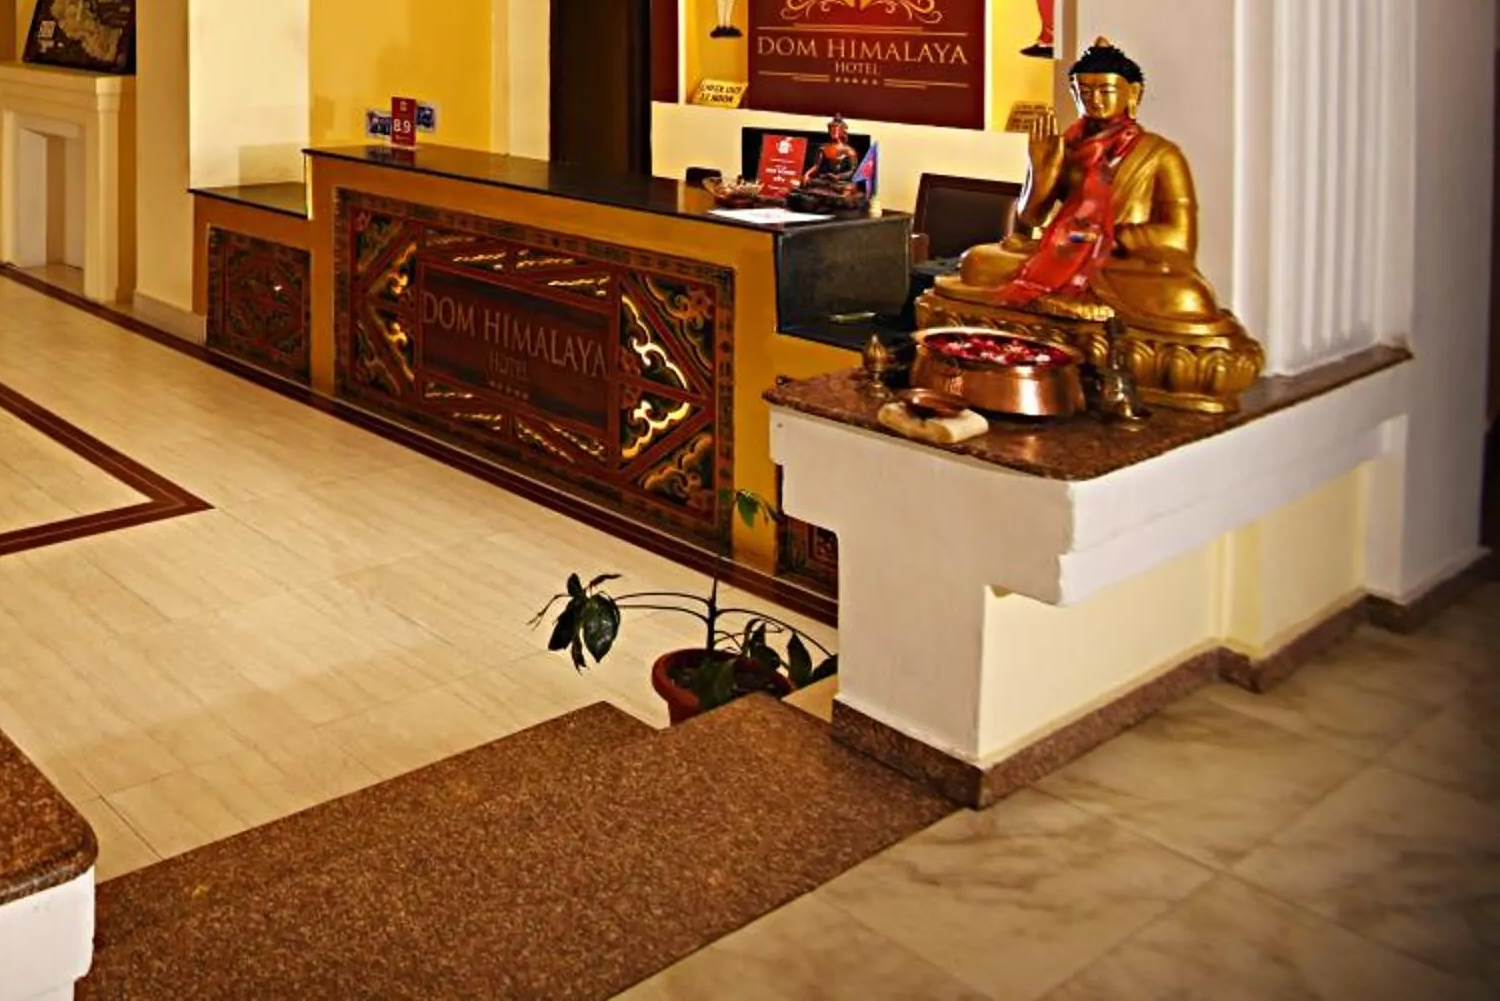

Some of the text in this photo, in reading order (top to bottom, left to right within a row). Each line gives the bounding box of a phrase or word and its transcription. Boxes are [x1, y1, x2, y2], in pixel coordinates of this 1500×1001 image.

[757, 36, 968, 66] DOM HIMALAYA
[835, 61, 881, 76] HOTEL
[422, 292, 608, 379] DOM HIMALAYA
